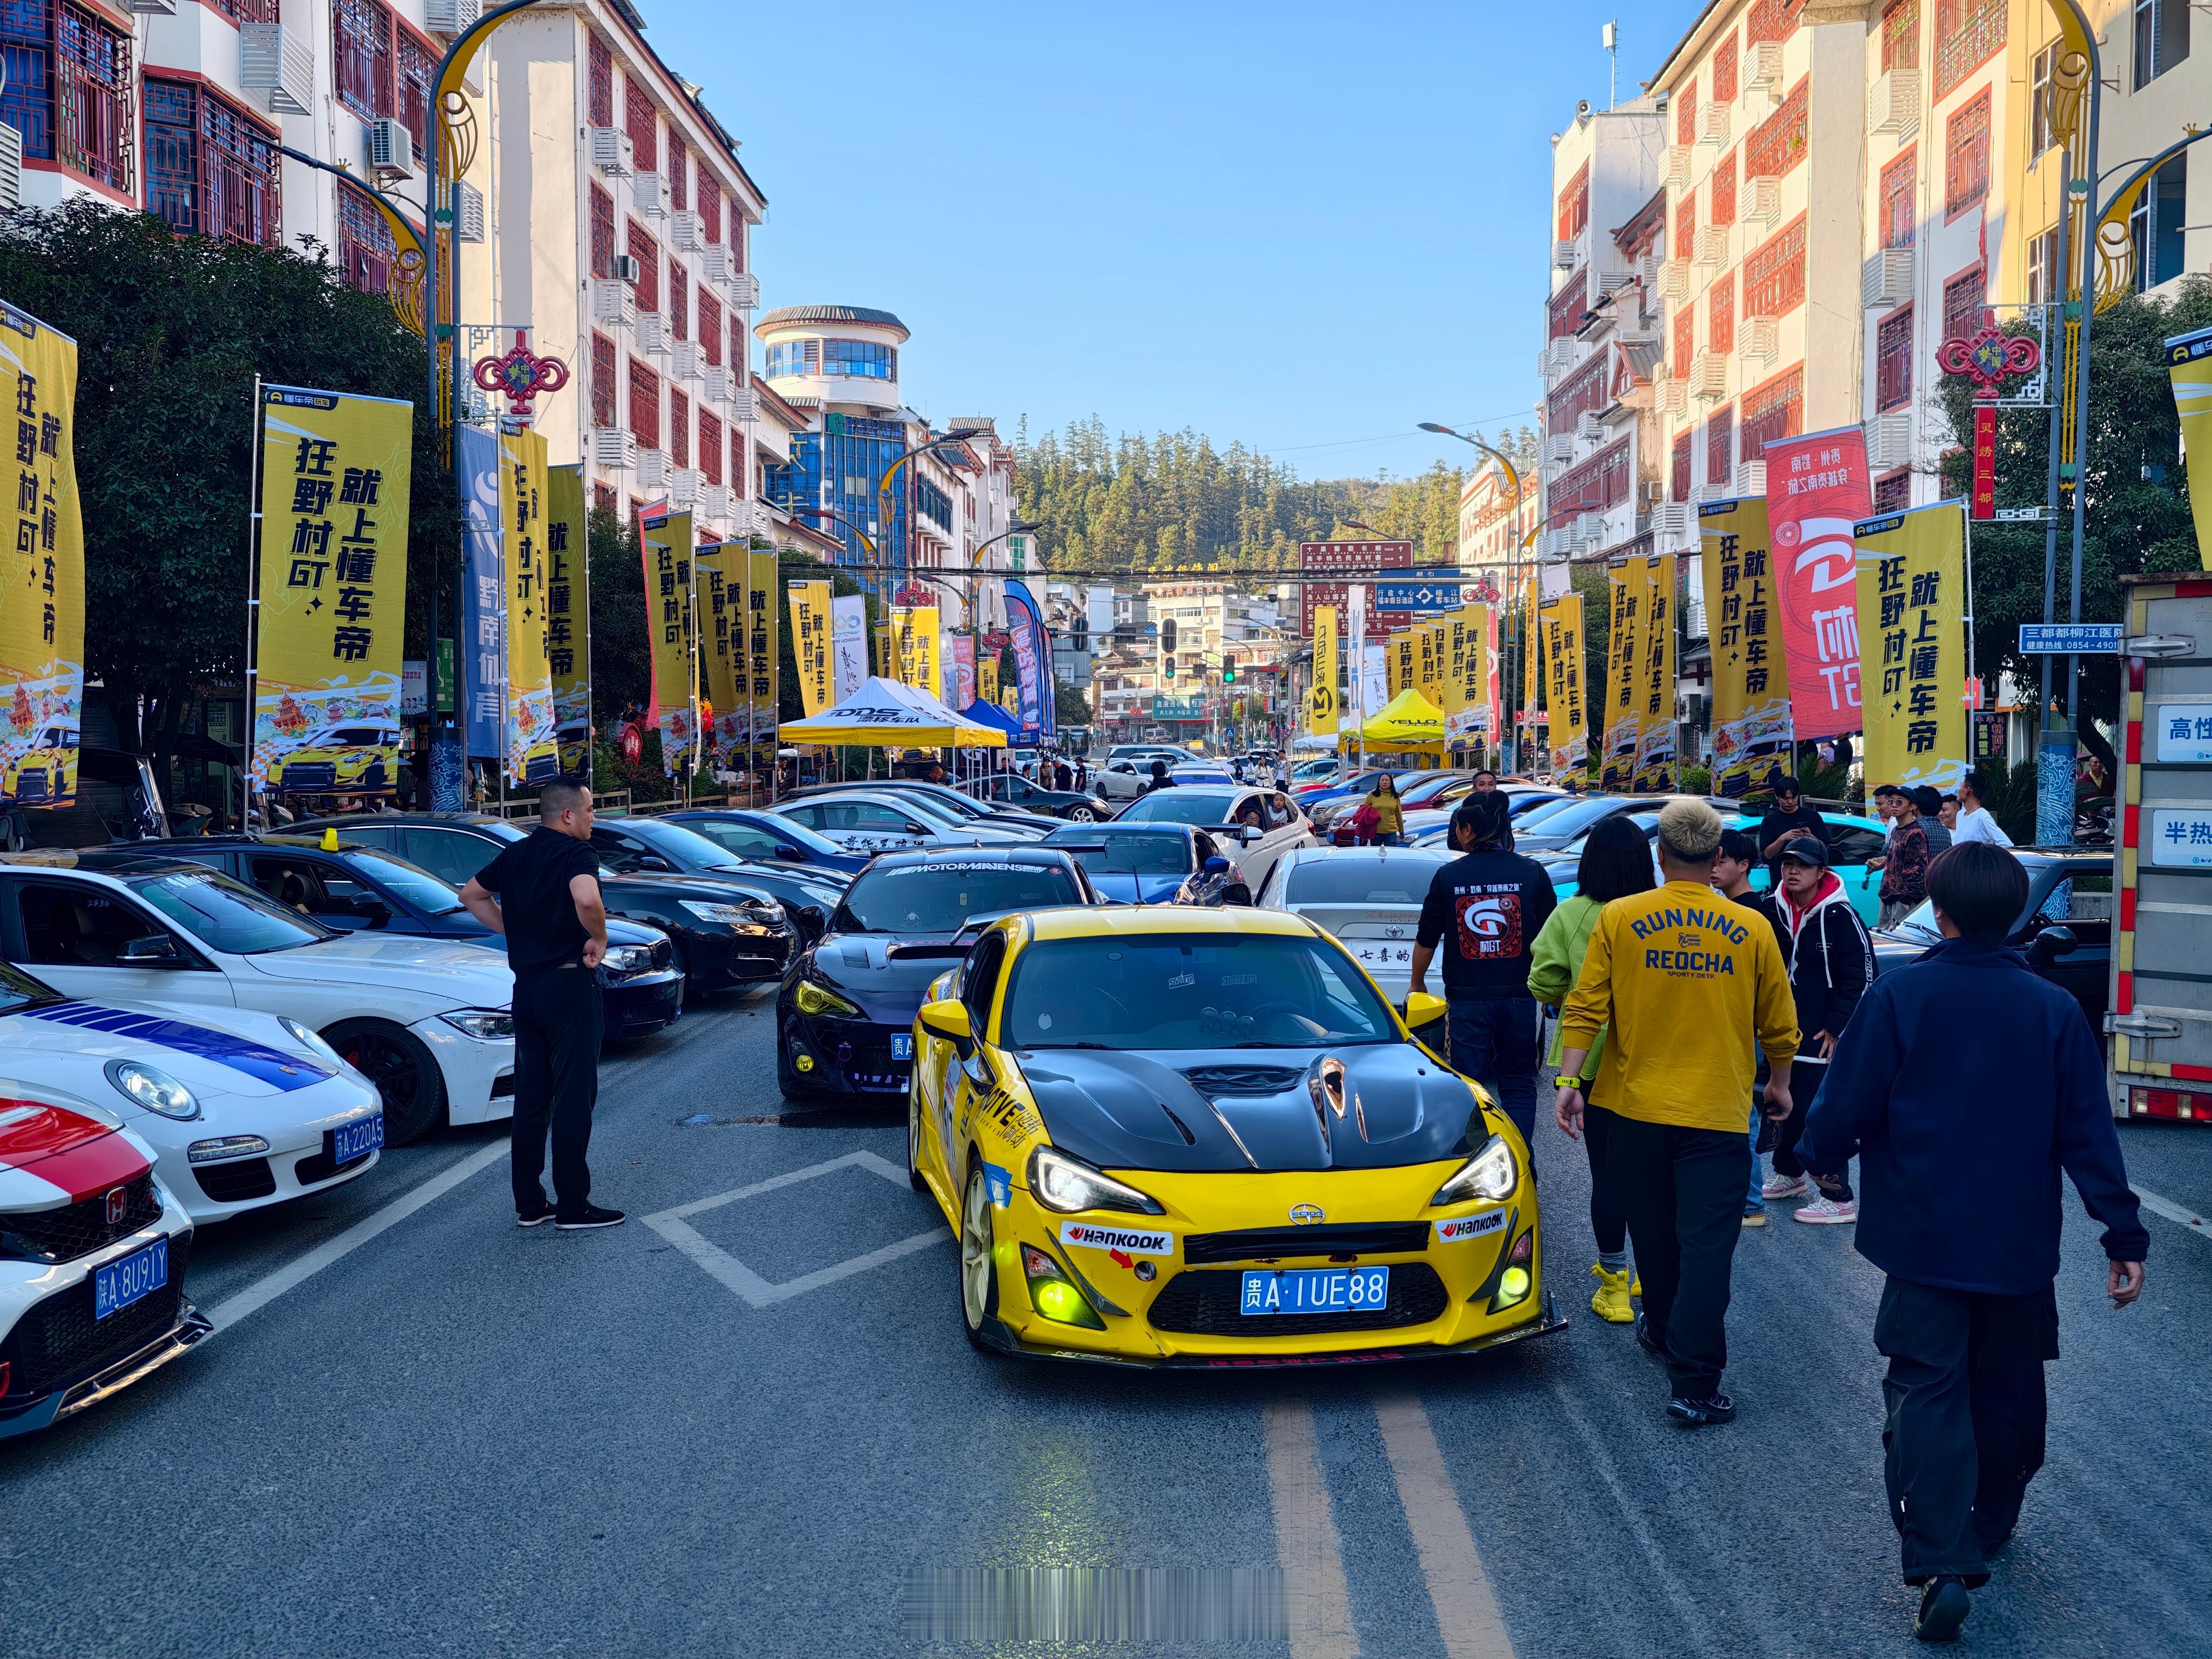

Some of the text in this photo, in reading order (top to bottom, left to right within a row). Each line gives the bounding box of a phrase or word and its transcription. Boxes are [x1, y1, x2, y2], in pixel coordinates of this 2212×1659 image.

[284, 394, 330, 407] 懂车帝 玩车
[17, 369, 38, 558] 狂野村GT
[1978, 422, 1993, 503] 灵绣三都
[286, 437, 339, 590] 狂野村GT
[333, 467, 383, 663] 就上懂车帝
[548, 522, 575, 677] 就上懂车帝
[657, 547, 681, 645] 狂野村GT
[1720, 534, 1742, 649] 狂野村GT
[710, 571, 730, 657] 狂野村GT
[726, 582, 747, 695] 就上懂车帝
[750, 590, 770, 698] 就上懂车帝
[799, 603, 814, 674] 狂野村GT
[901, 626, 915, 684] 狂野村GT
[1452, 622, 1465, 677] 狂野村GT
[1611, 584, 1627, 671] 狂野村GT
[1620, 596, 1637, 709] 就上懂车帝
[1649, 597, 1667, 716] 就上懂车帝
[1742, 550, 1769, 696] 就上懂车帝
[1878, 556, 1908, 697] 狂野村GT
[2025, 628, 2123, 638] 三都都柳江医院
[813, 614, 825, 705] 就上懂车帝
[1400, 642, 1413, 690] 狂野村GT
[1421, 633, 1435, 684] 狂野村GT
[1465, 629, 1478, 701] 就上懂车帝
[1550, 621, 1565, 698] 狂野村GT
[1564, 630, 1581, 727] 就上懂车帝
[1907, 571, 1940, 756] 就上懂车帝
[1480, 940, 1501, 953] 村GT
[1630, 908, 1749, 945] RUNNING
[1645, 949, 1734, 975] REOCHA
[337, 1117, 383, 1157] 苏A·220A5
[1246, 1273, 1384, 1308] 贵A·1UE88
